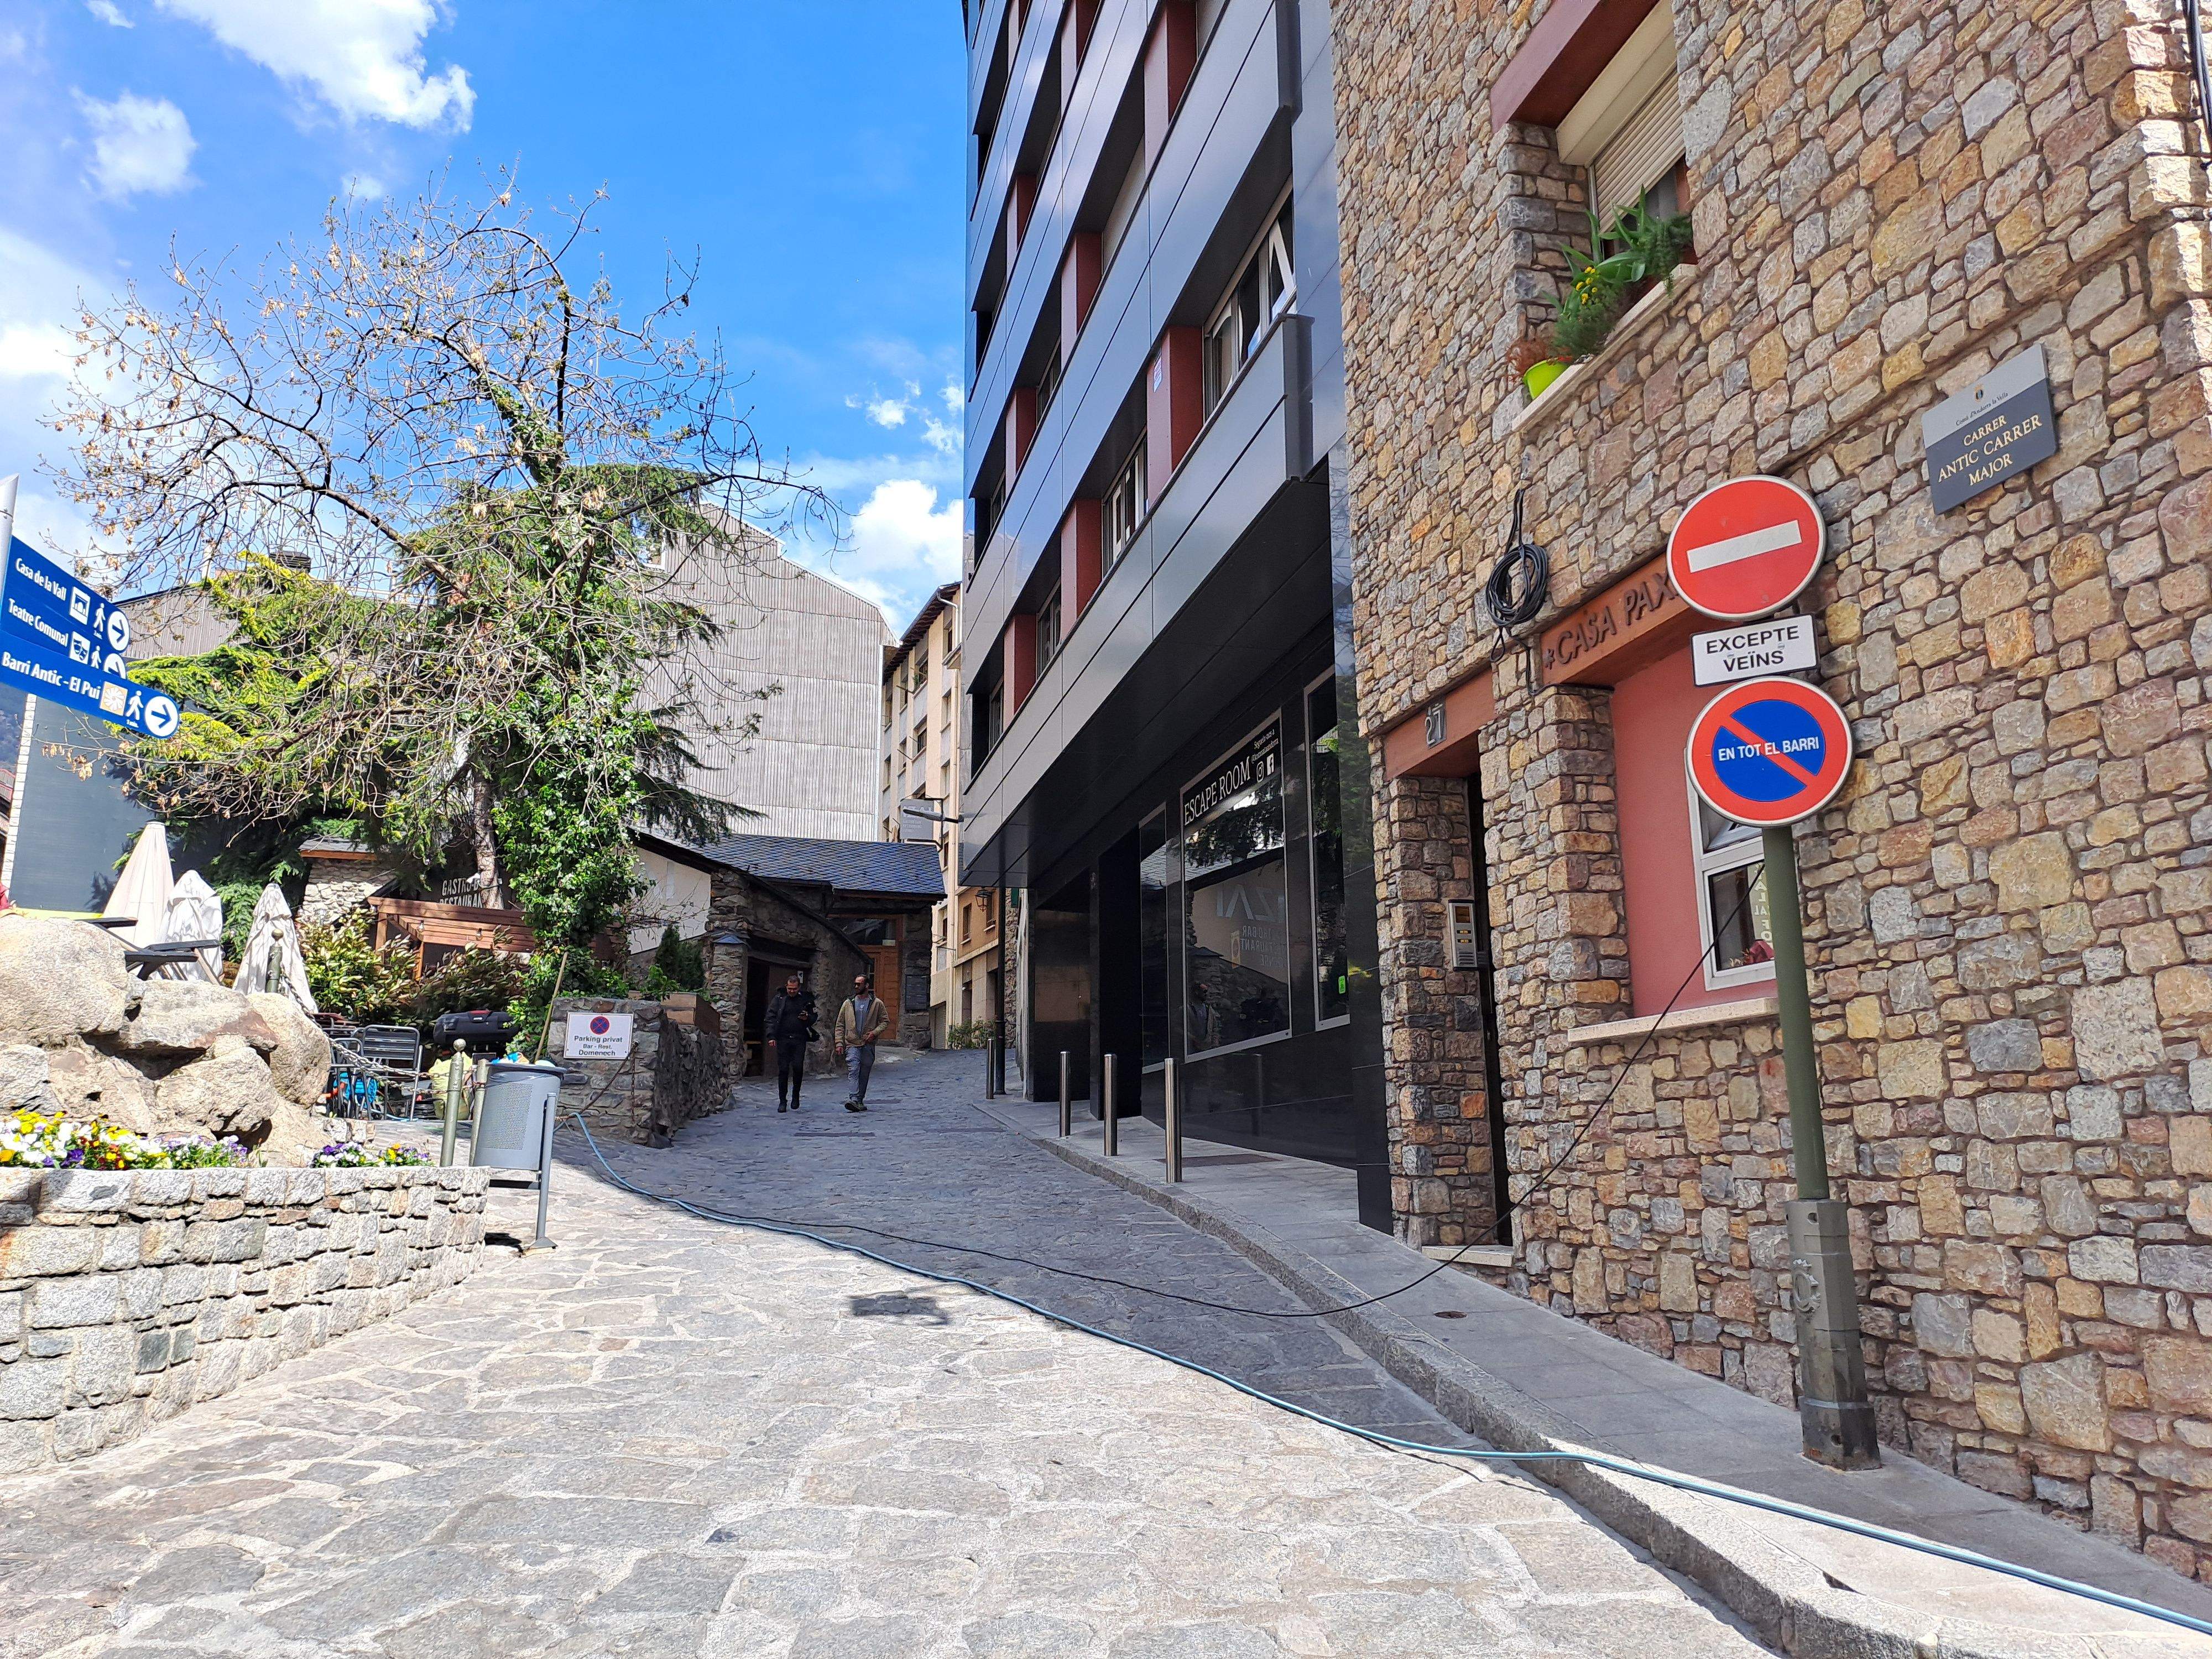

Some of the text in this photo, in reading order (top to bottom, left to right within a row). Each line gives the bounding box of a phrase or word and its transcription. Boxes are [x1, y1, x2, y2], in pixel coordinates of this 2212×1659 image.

[1938, 414, 2043, 482] ANTIC CARRER
[1964, 415, 2007, 446] CARRER
[1969, 453, 2013, 486] MAJOR
[15, 558, 67, 601] Casa de la Vall
[8, 598, 69, 648] Teatre Comunal
[1556, 606, 1616, 664] CASA
[1707, 625, 1799, 654] EXCEPTE
[2, 651, 31, 675] Barri
[30, 664, 62, 686] Antic
[69, 676, 81, 692] El
[81, 681, 101, 700] Pui
[1723, 650, 1784, 672] VEÏNS
[1718, 736, 1820, 761] EN TOT EL BARRI
[1185, 756, 1250, 826] ESCAPE ROOM
